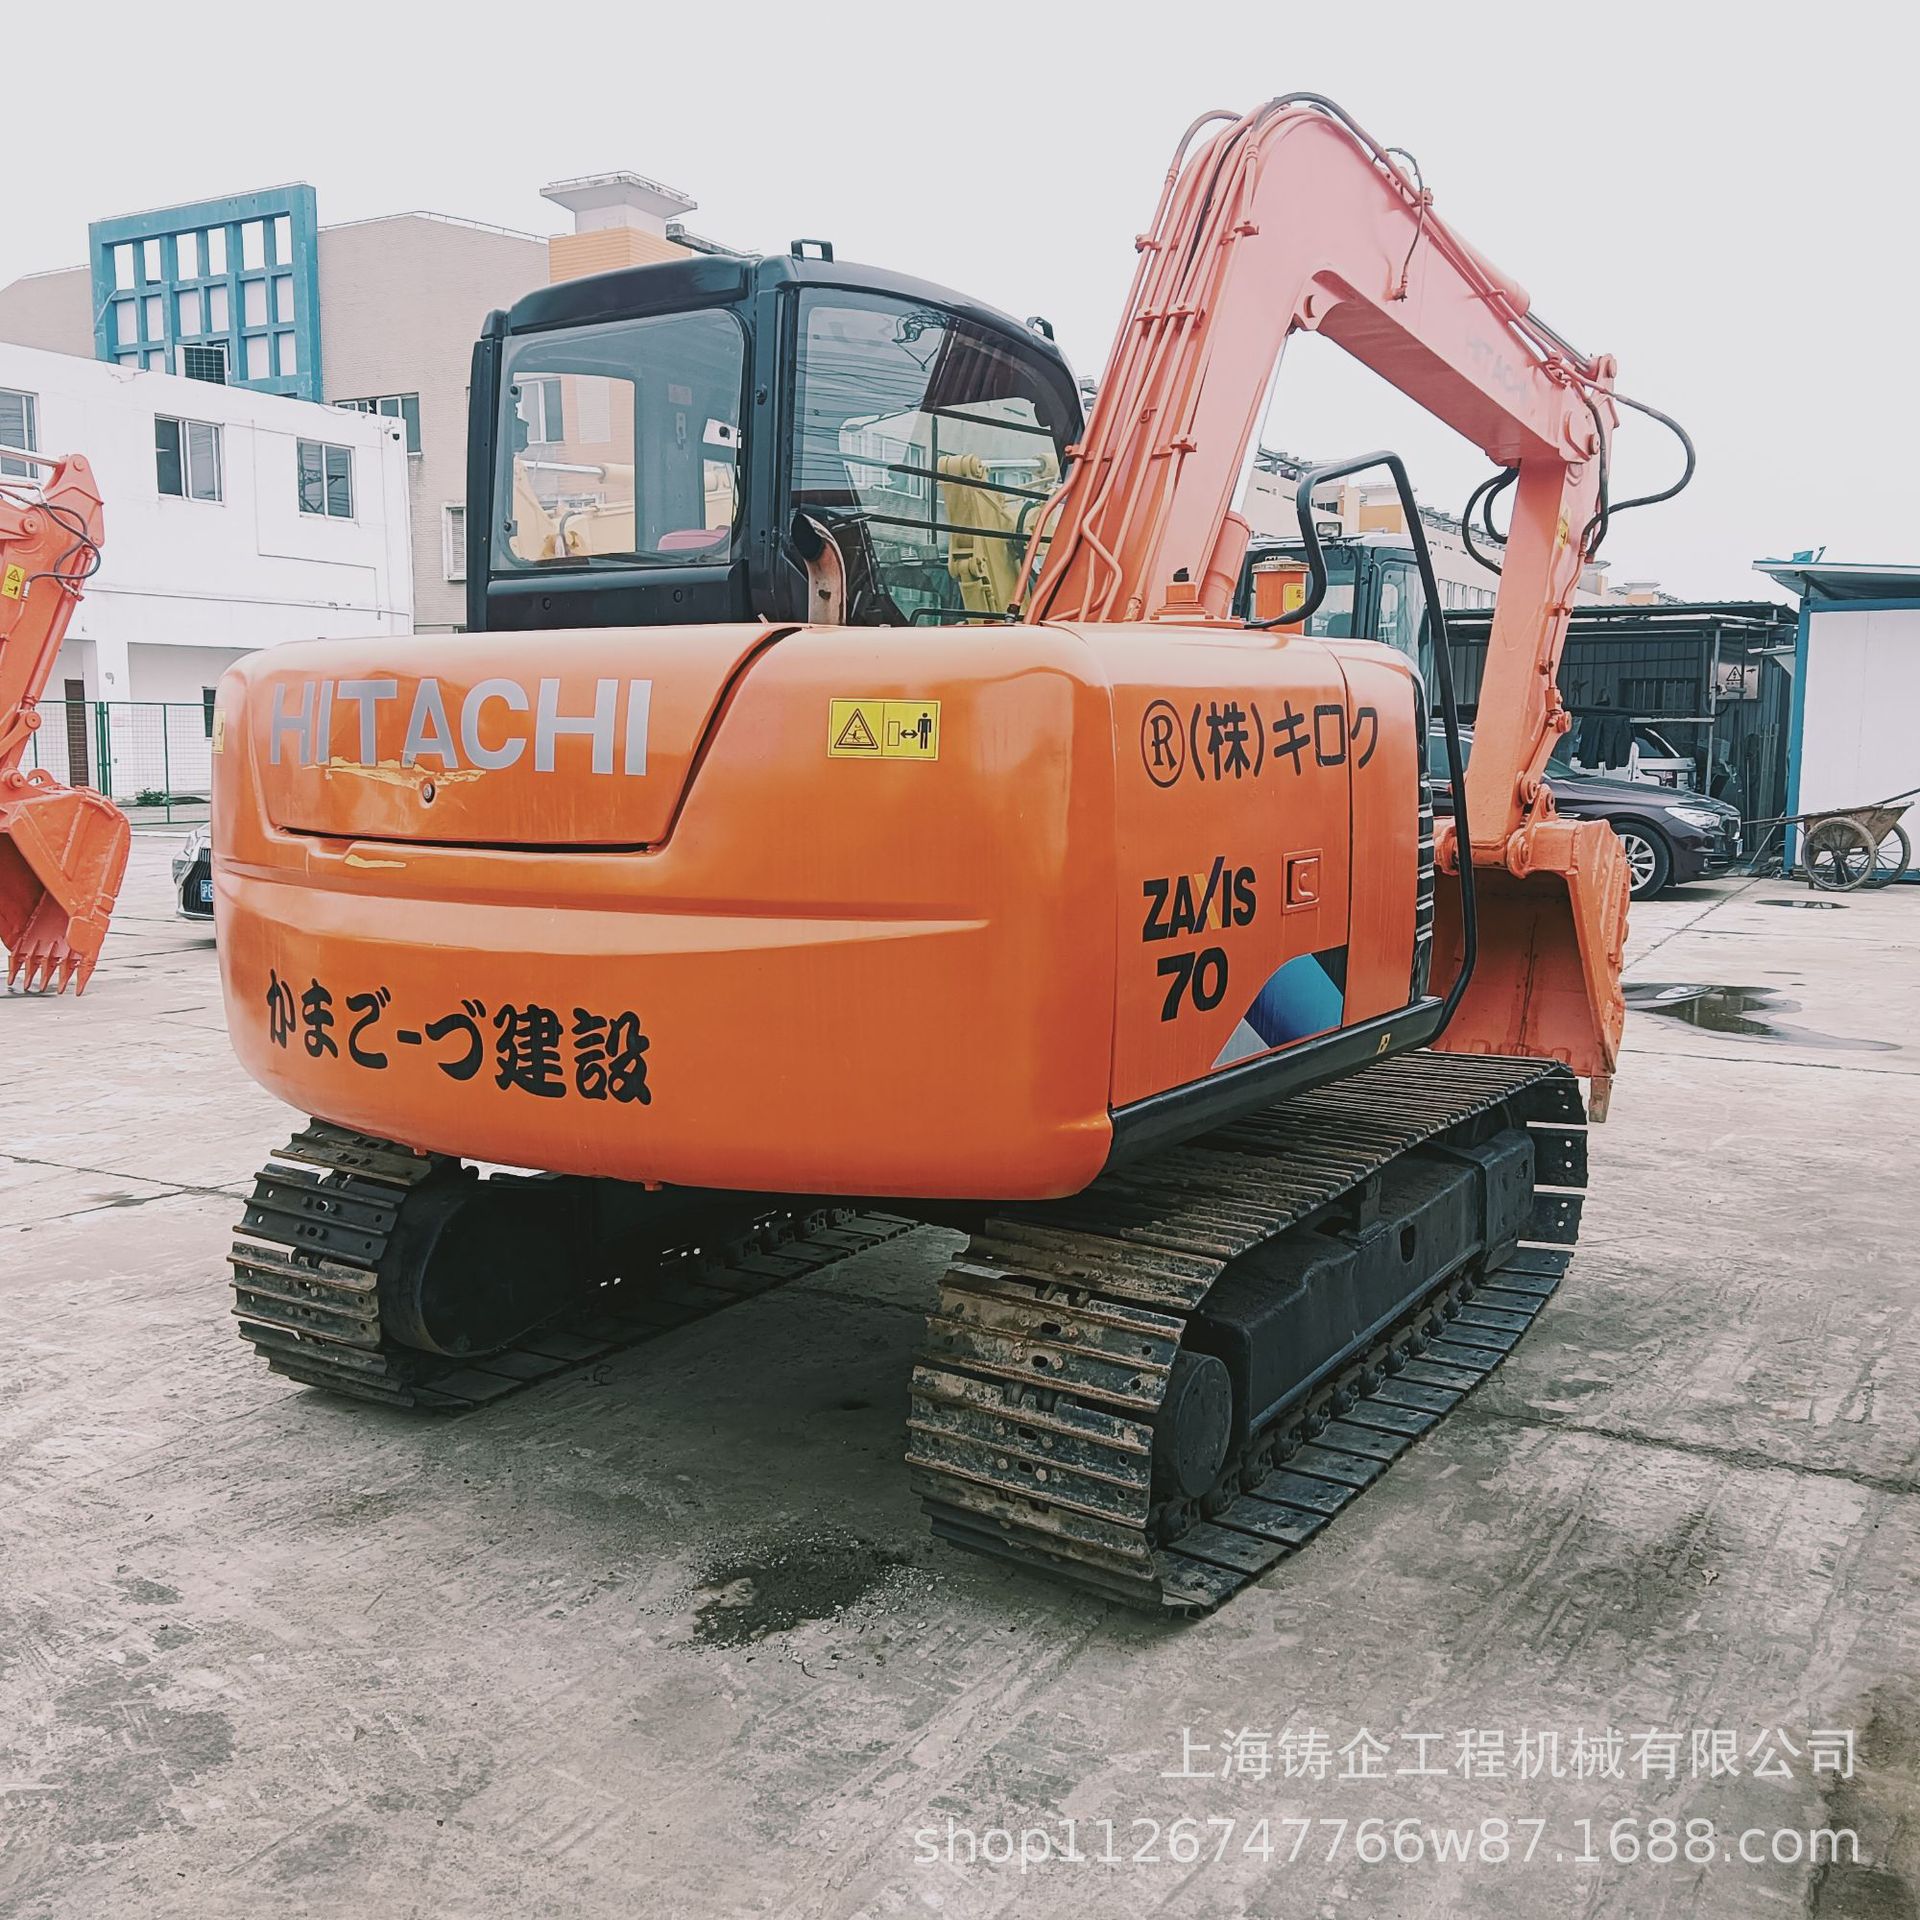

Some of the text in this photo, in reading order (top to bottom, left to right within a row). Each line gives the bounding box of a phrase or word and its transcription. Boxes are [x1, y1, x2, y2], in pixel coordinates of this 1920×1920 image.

[269, 677, 653, 776] HITACHI
[1142, 855, 1257, 942] ZAXIS
[1156, 946, 1229, 1022] 70
